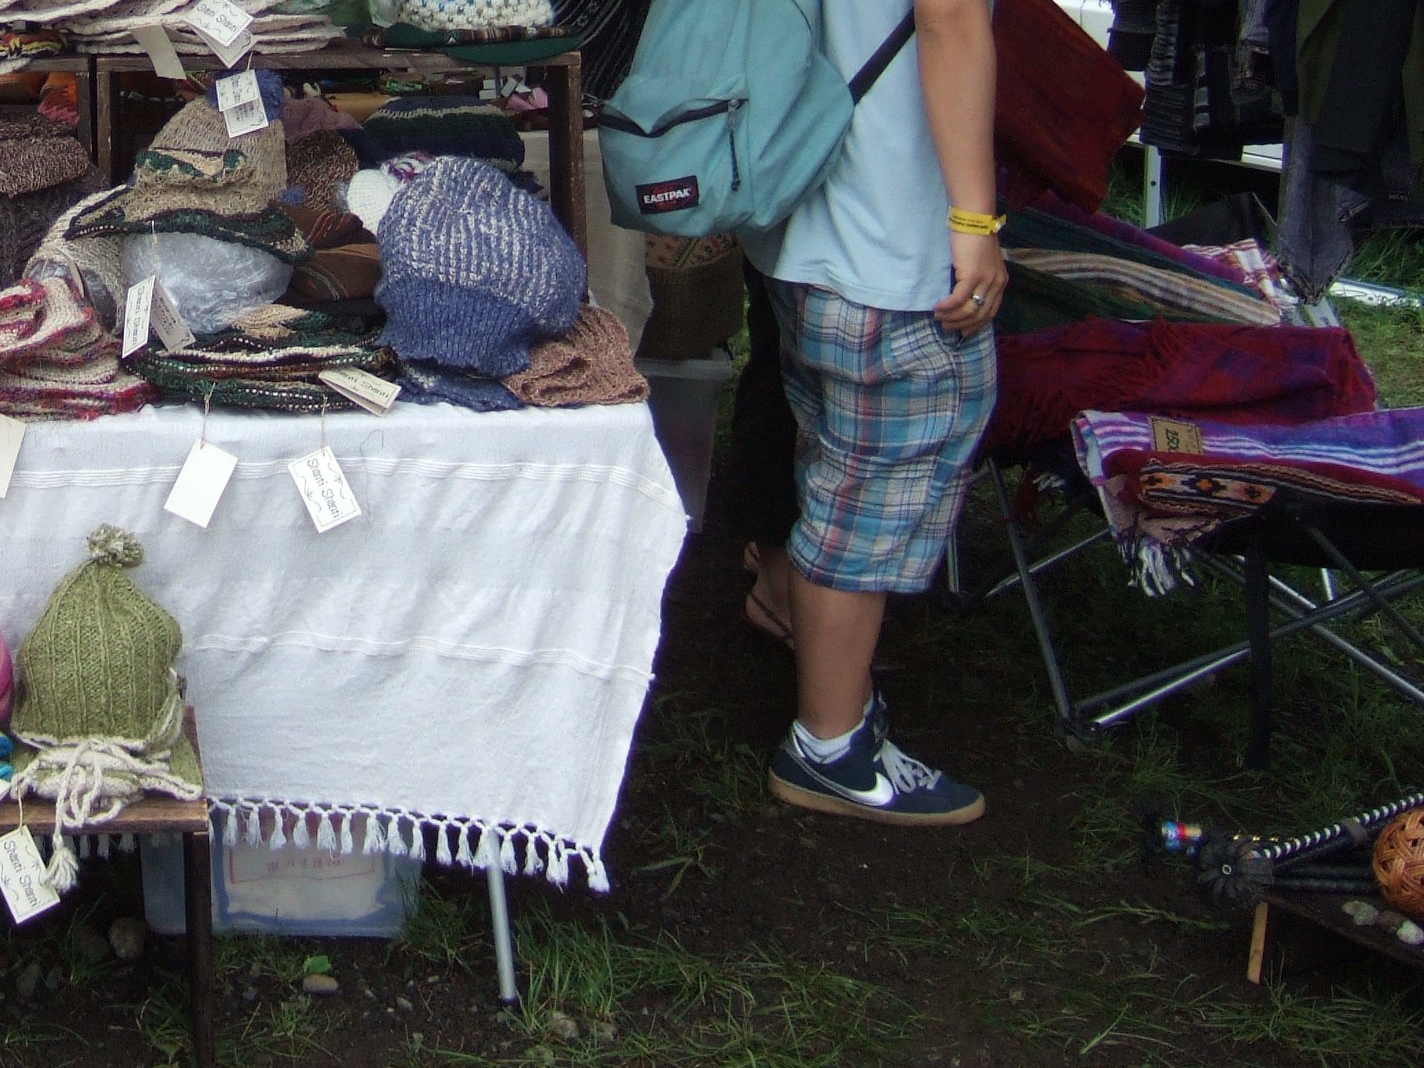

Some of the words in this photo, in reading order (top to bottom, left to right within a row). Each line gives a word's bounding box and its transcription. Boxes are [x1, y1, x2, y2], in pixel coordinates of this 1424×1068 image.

[643, 188, 691, 204] EASTPAK
[307, 458, 329, 487] Shanti
[321, 488, 343, 518] Shanti
[3, 840, 26, 873] Shanti
[19, 875, 41, 909] Shanti
